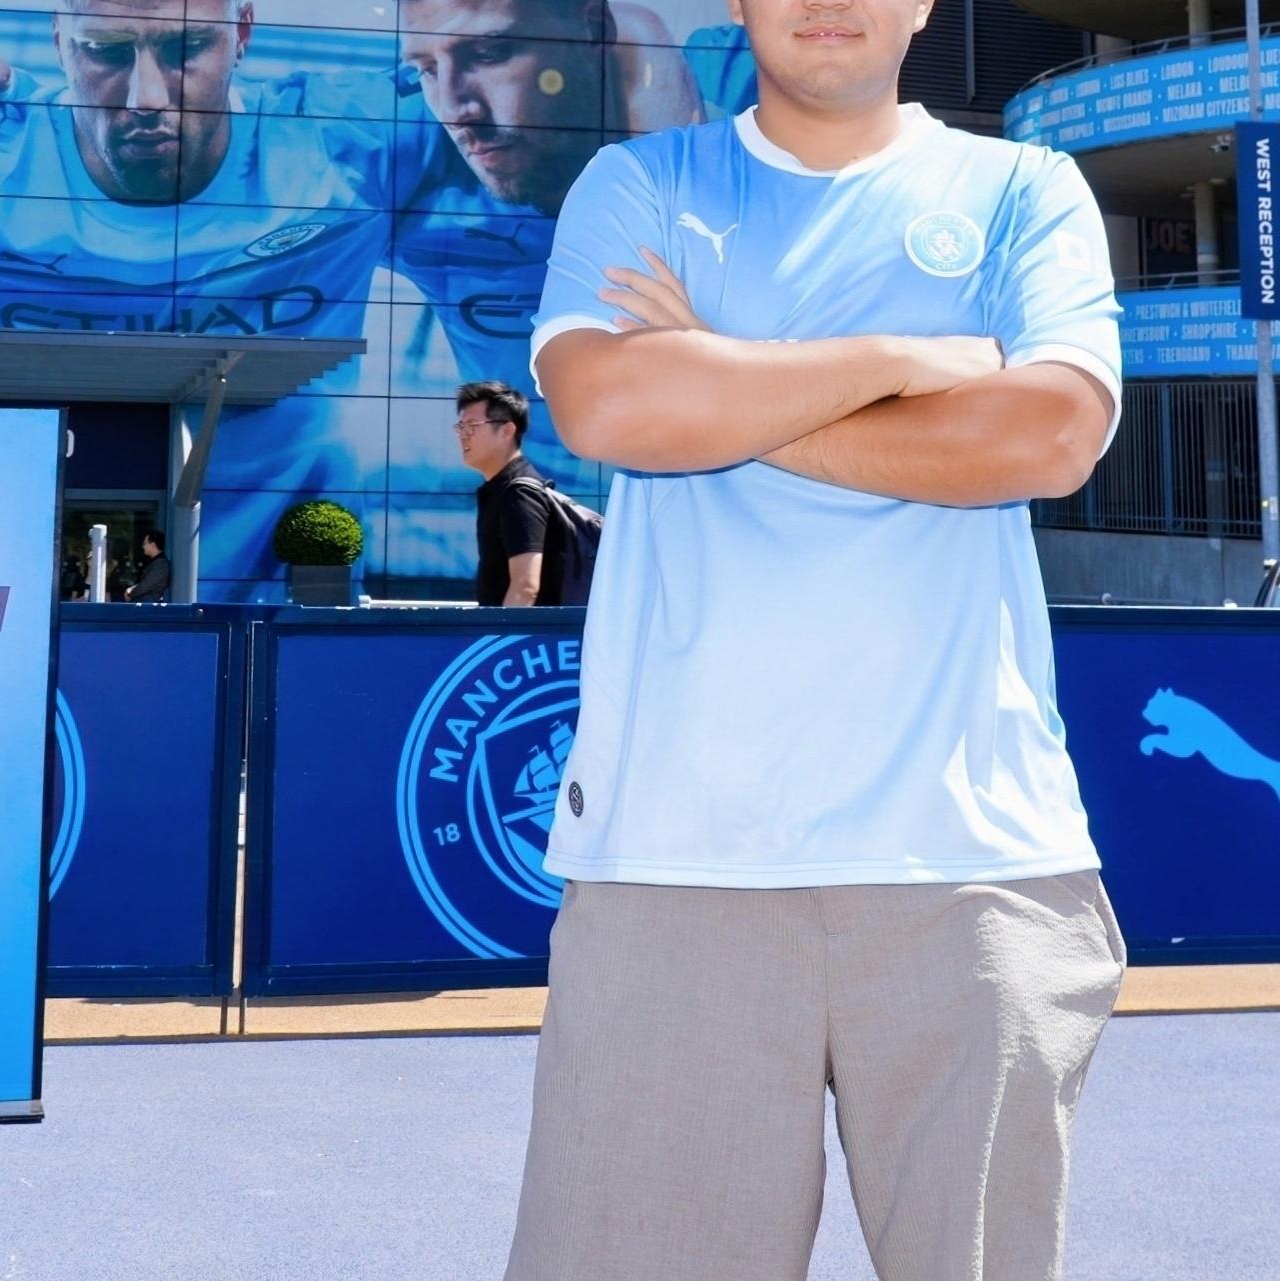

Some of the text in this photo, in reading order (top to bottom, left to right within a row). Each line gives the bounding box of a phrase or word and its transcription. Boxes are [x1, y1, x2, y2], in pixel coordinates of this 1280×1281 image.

[1256, 138, 1275, 304] WEST RECEPTION
[429, 640, 580, 783] MANCHE
[432, 823, 461, 847] 18
